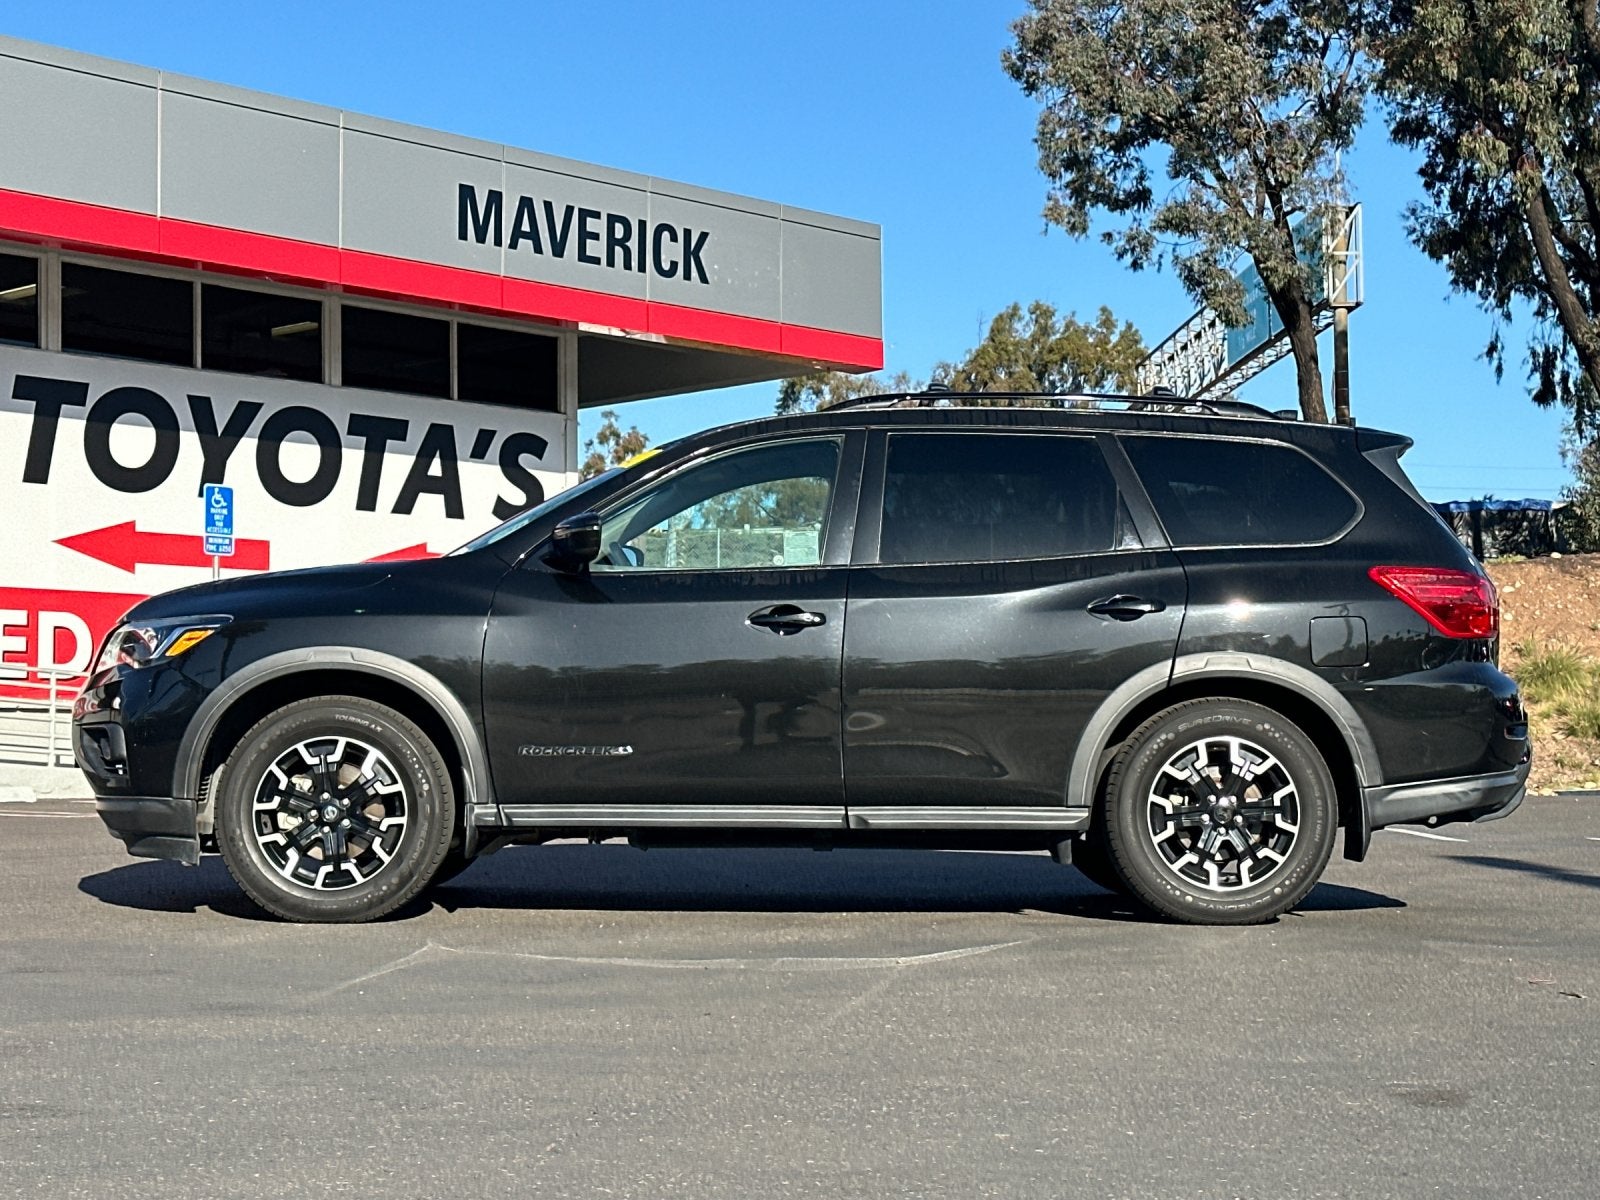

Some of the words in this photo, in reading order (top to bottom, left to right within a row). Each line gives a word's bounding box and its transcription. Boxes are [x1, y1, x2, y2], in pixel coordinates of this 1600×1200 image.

[458, 183, 710, 284] MAVERICK
[12, 374, 548, 520] TOYOTA'S
[335, 714, 369, 727] TOURING
